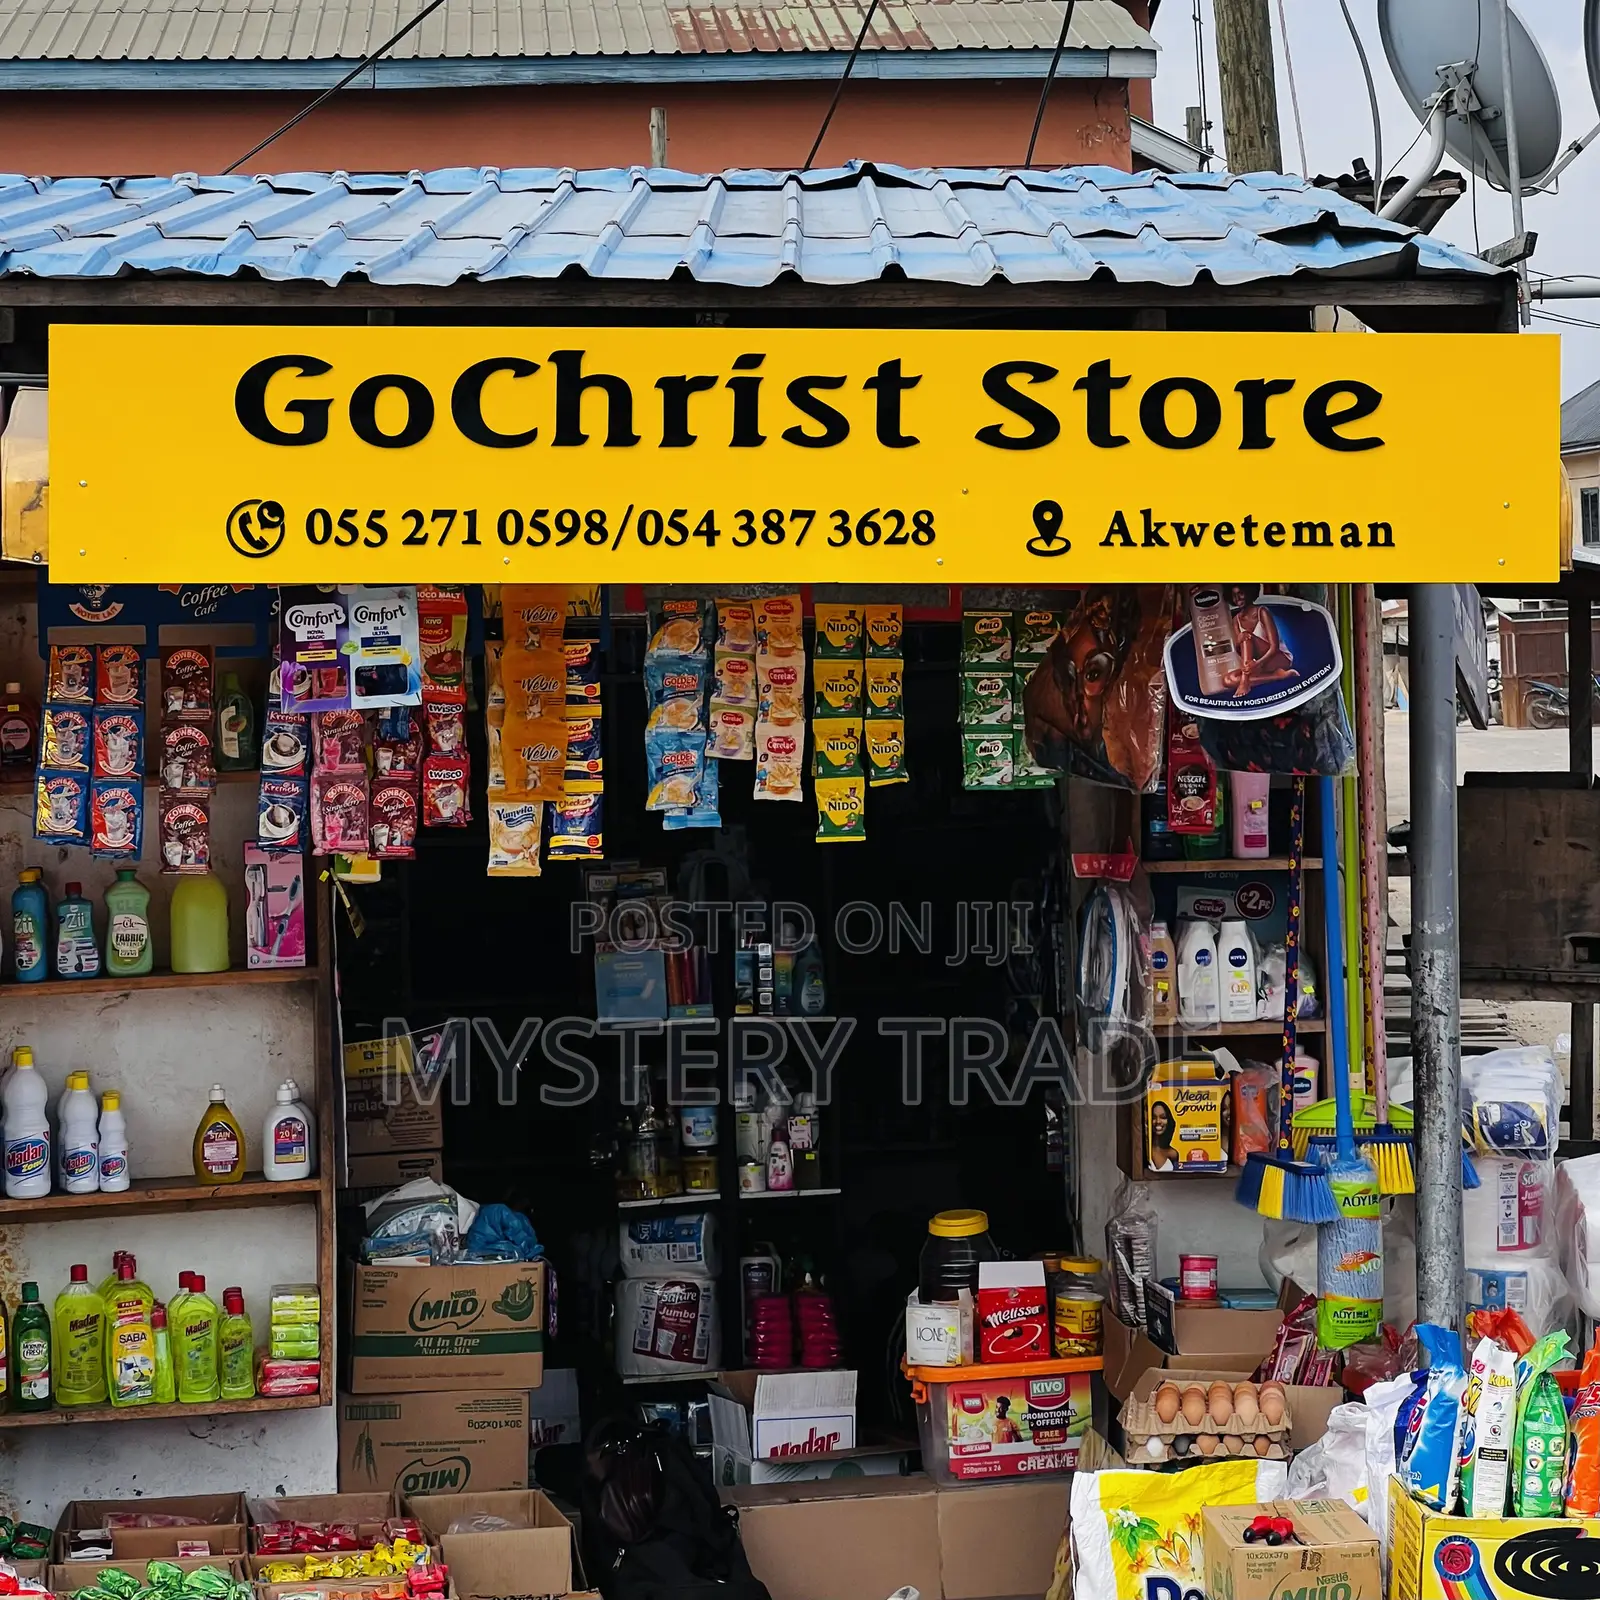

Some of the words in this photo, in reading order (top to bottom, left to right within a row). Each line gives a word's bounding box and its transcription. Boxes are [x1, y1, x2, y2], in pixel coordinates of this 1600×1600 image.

[234, 350, 923, 448] GoChrist
[974, 358, 1386, 451] Store
[305, 507, 389, 548] 055
[401, 508, 482, 547] 271
[498, 503, 721, 550] 0598/054
[731, 507, 813, 548] 387
[827, 509, 936, 547] 3628
[1099, 508, 1396, 547] Akweteman
[181, 585, 228, 607] Coffee
[194, 601, 218, 617] Café
[663, 600, 697, 611] GOLDEN
[75, 605, 100, 621] NOTRE
[102, 605, 119, 618] LAIT
[289, 609, 342, 628] Comfort
[354, 604, 407, 623] Comfort
[521, 604, 560, 622] Webie
[1028, 613, 1050, 622] MILO
[1197, 613, 1219, 622] Cocoa
[827, 623, 857, 632] NIDO
[871, 624, 899, 633] NIDO
[979, 622, 1000, 630] MILO
[102, 645, 140, 662] COWBELL
[168, 650, 208, 667] COWBELL
[175, 664, 198, 675] Coffee
[664, 675, 698, 686] GOLDEN
[769, 672, 795, 681] Cerelac
[521, 674, 561, 693] Webie
[825, 683, 856, 692] NIDO
[870, 685, 898, 694] NIDO
[978, 683, 1000, 692] MILO
[1184, 694, 1199, 703] FOR
[1199, 697, 1243, 707] BEAUTIFULLY
[1244, 690, 1287, 706] MOISTURIZED
[1287, 684, 1302, 695] SKIN
[1302, 664, 1332, 687] EVERYDAY
[428, 703, 462, 714] twisco
[102, 716, 138, 732] COWBELL
[175, 741, 198, 753] Coffee
[521, 744, 561, 761] Webie
[826, 741, 857, 751] NIDO
[872, 744, 900, 754] NIDO
[979, 745, 1000, 753] MILO
[428, 769, 463, 779] twisco
[47, 778, 80, 794] COWBELL
[97, 788, 136, 805] COWBELL
[324, 785, 365, 802] COWBELL
[373, 788, 416, 805] COWBELL
[828, 801, 858, 811] NIDO
[166, 804, 207, 822] COWBELL
[496, 805, 534, 821] Yumvita
[174, 820, 196, 830] Coffee
[1194, 903, 1224, 913] Cerelac
[14, 917, 34, 934] Zii
[66, 913, 85, 929] Zii
[116, 933, 144, 942] FABRIC
[1174, 1089, 1210, 1105] Mega
[347, 1100, 385, 1113] erelac
[1175, 1101, 1217, 1116] Growth
[209, 1131, 230, 1140] STAIN
[279, 1130, 290, 1139] 20
[7, 1144, 44, 1168] Madar
[1342, 1195, 1372, 1207] AOYI
[420, 1299, 479, 1322] MILO
[659, 1306, 696, 1319] Jumbo
[1333, 1310, 1355, 1319] AOYI
[69, 1313, 100, 1332] Madar
[185, 1319, 211, 1336] Madar
[119, 1333, 147, 1344] SABA
[414, 1337, 434, 1347] All
[437, 1337, 449, 1347] In
[454, 1336, 480, 1347] One
[421, 1347, 471, 1355] Nutri-Mix
[1032, 1381, 1063, 1394] KIVO
[1021, 1409, 1077, 1420] PROMOTIONAL
[467, 1419, 522, 1430] 30x10x20g
[1036, 1418, 1064, 1427] OFFER!
[769, 1427, 841, 1459] Madar
[402, 1467, 460, 1492] MILO
[1246, 1551, 1289, 1560] 10x20x37g
